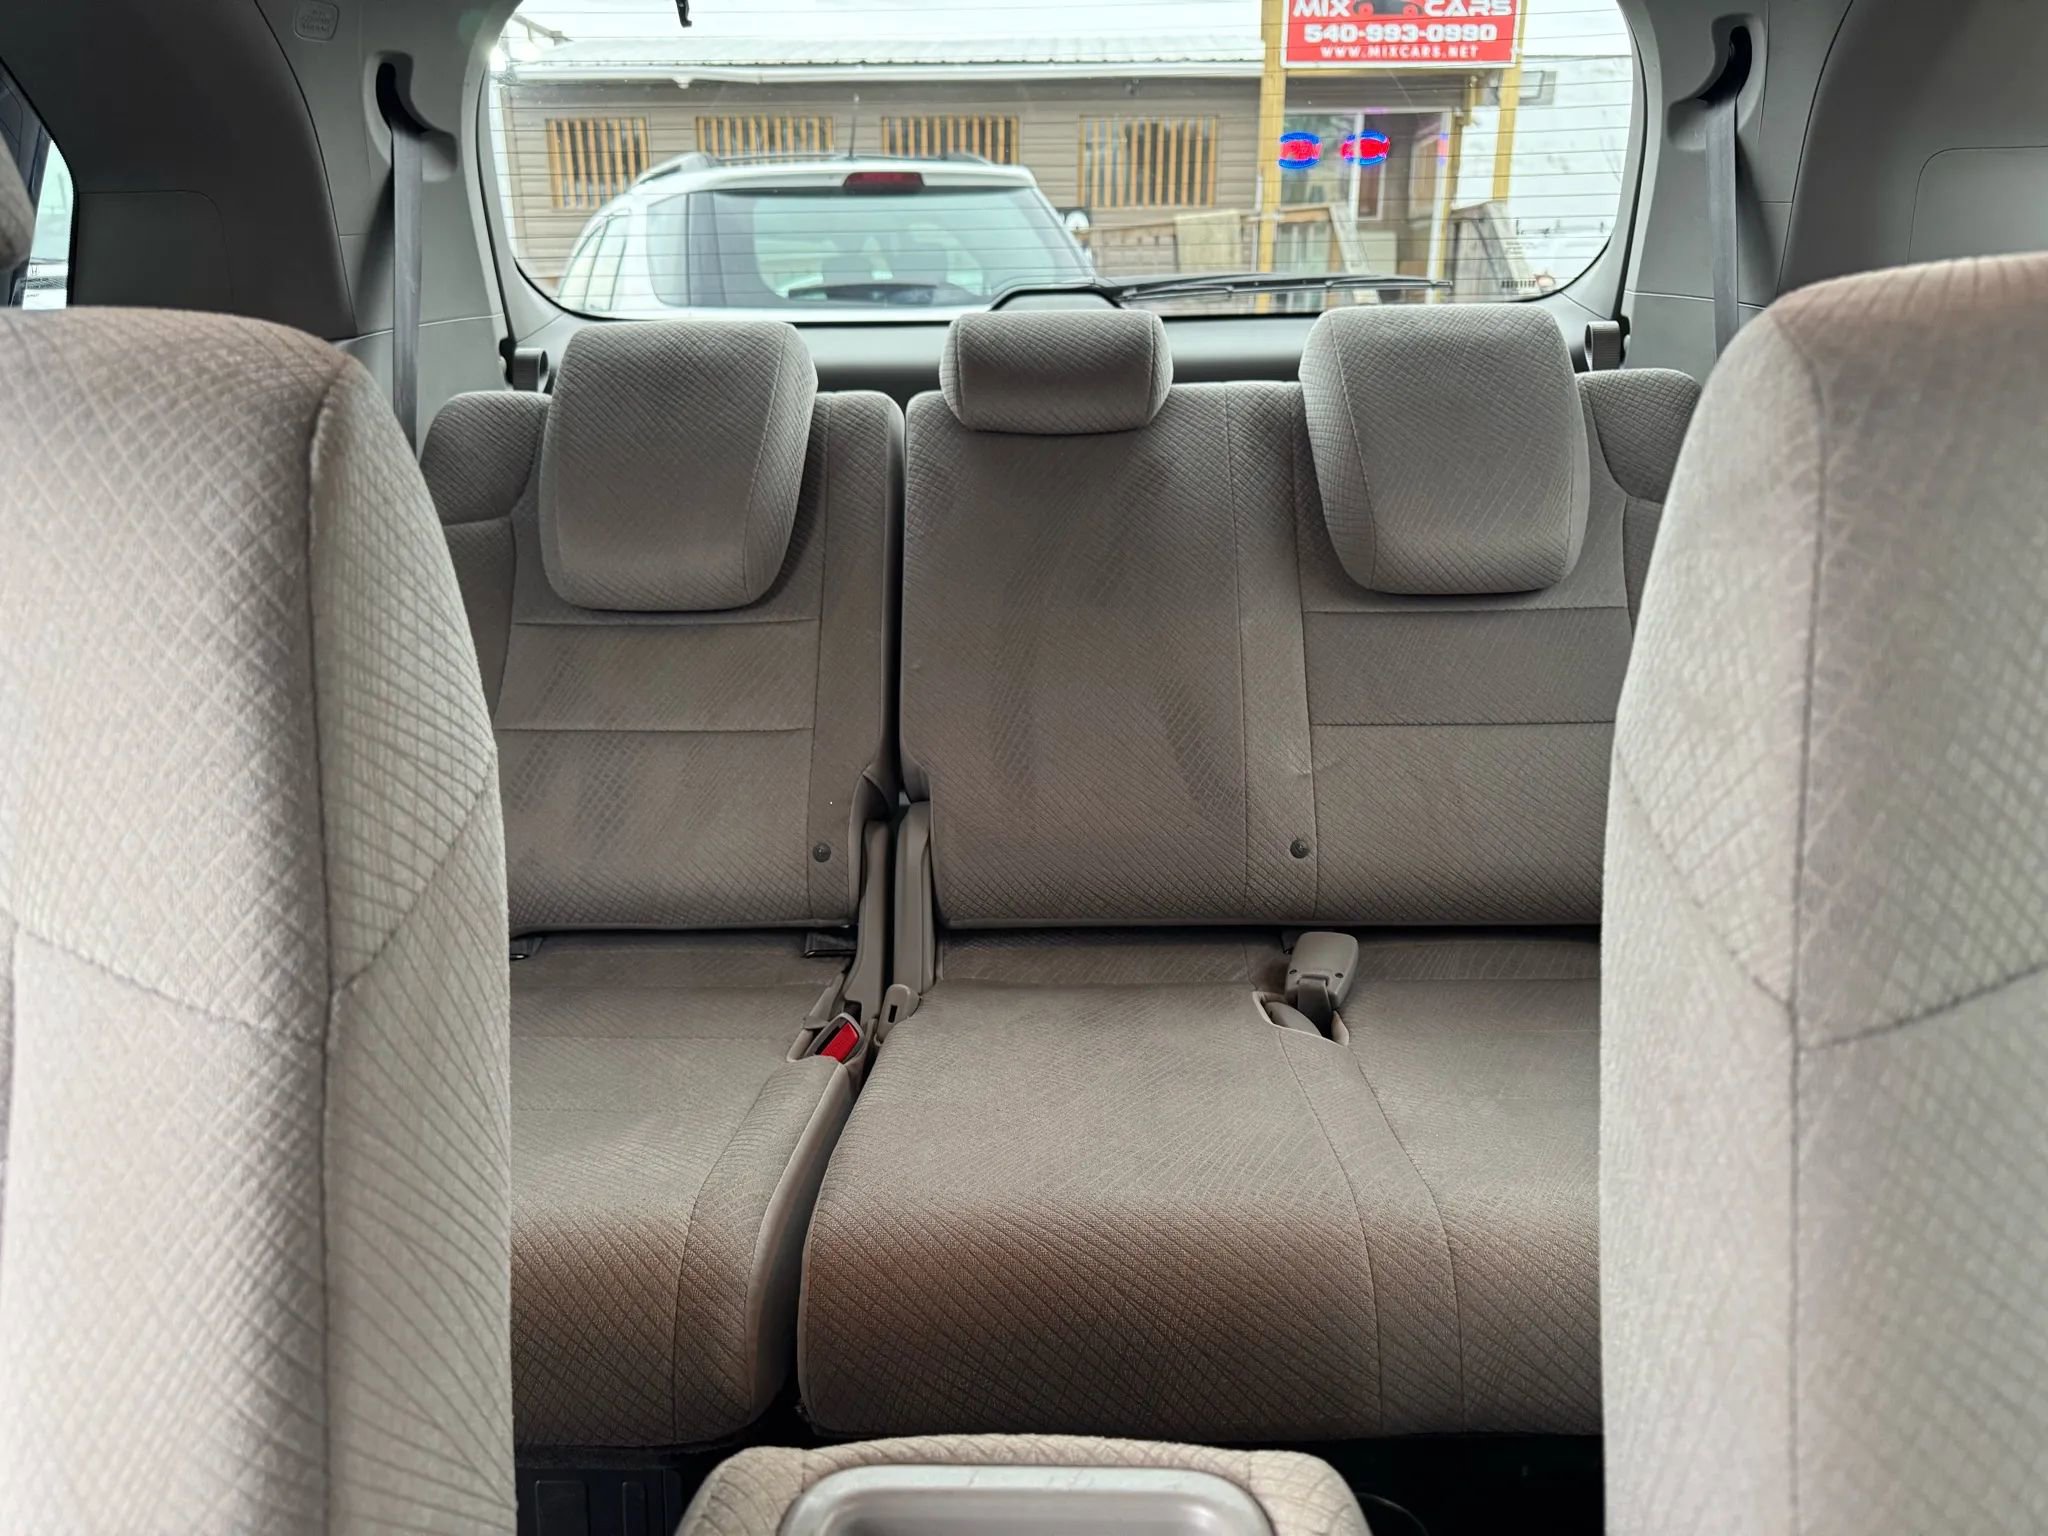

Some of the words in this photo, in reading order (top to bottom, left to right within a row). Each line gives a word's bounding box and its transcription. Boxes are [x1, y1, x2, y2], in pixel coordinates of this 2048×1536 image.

[1293, 0, 1351, 17] MIX
[1424, 0, 1513, 17] CARS
[1320, 45, 1479, 59] WWW.MIXCARS.NET
